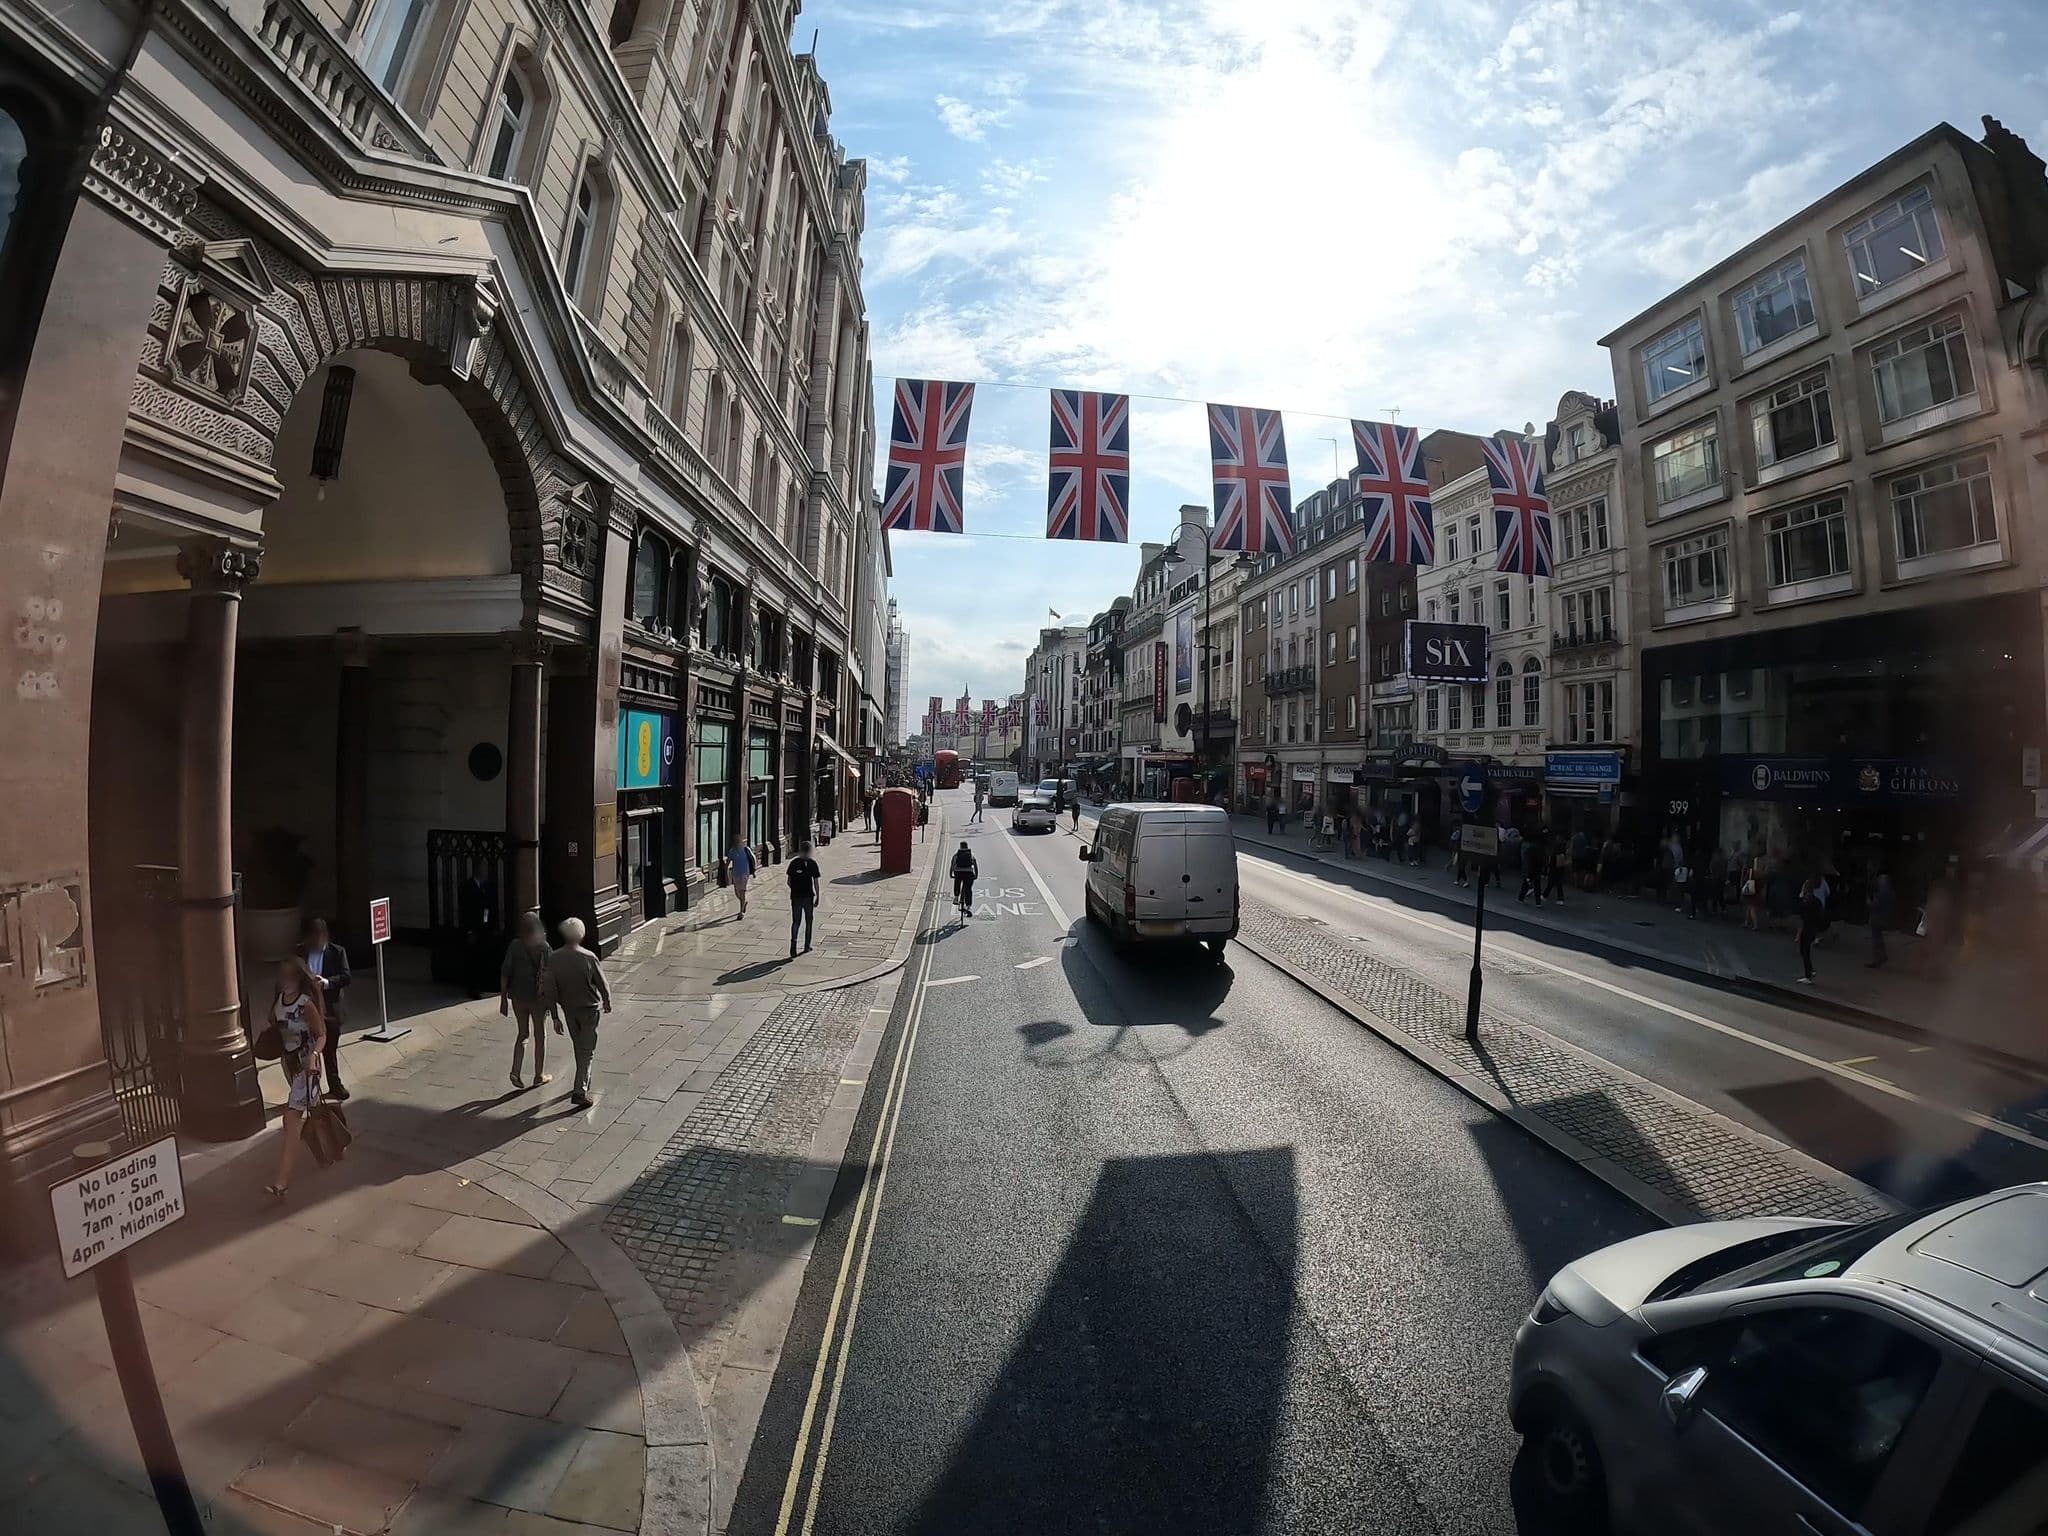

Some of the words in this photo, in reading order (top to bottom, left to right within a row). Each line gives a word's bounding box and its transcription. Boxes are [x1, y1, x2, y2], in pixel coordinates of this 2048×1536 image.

[1487, 767, 1535, 777] VAUDEVILLE
[1669, 800, 1689, 815] 399
[79, 1181, 101, 1198] No
[105, 1154, 157, 1186] loading
[84, 1193, 115, 1217] Mon
[131, 1172, 158, 1194] Sun
[72, 1241, 106, 1264] 4pm
[120, 1198, 180, 1240] Midnight
[82, 1214, 114, 1238] 7am
[128, 1189, 165, 1216] 10am
